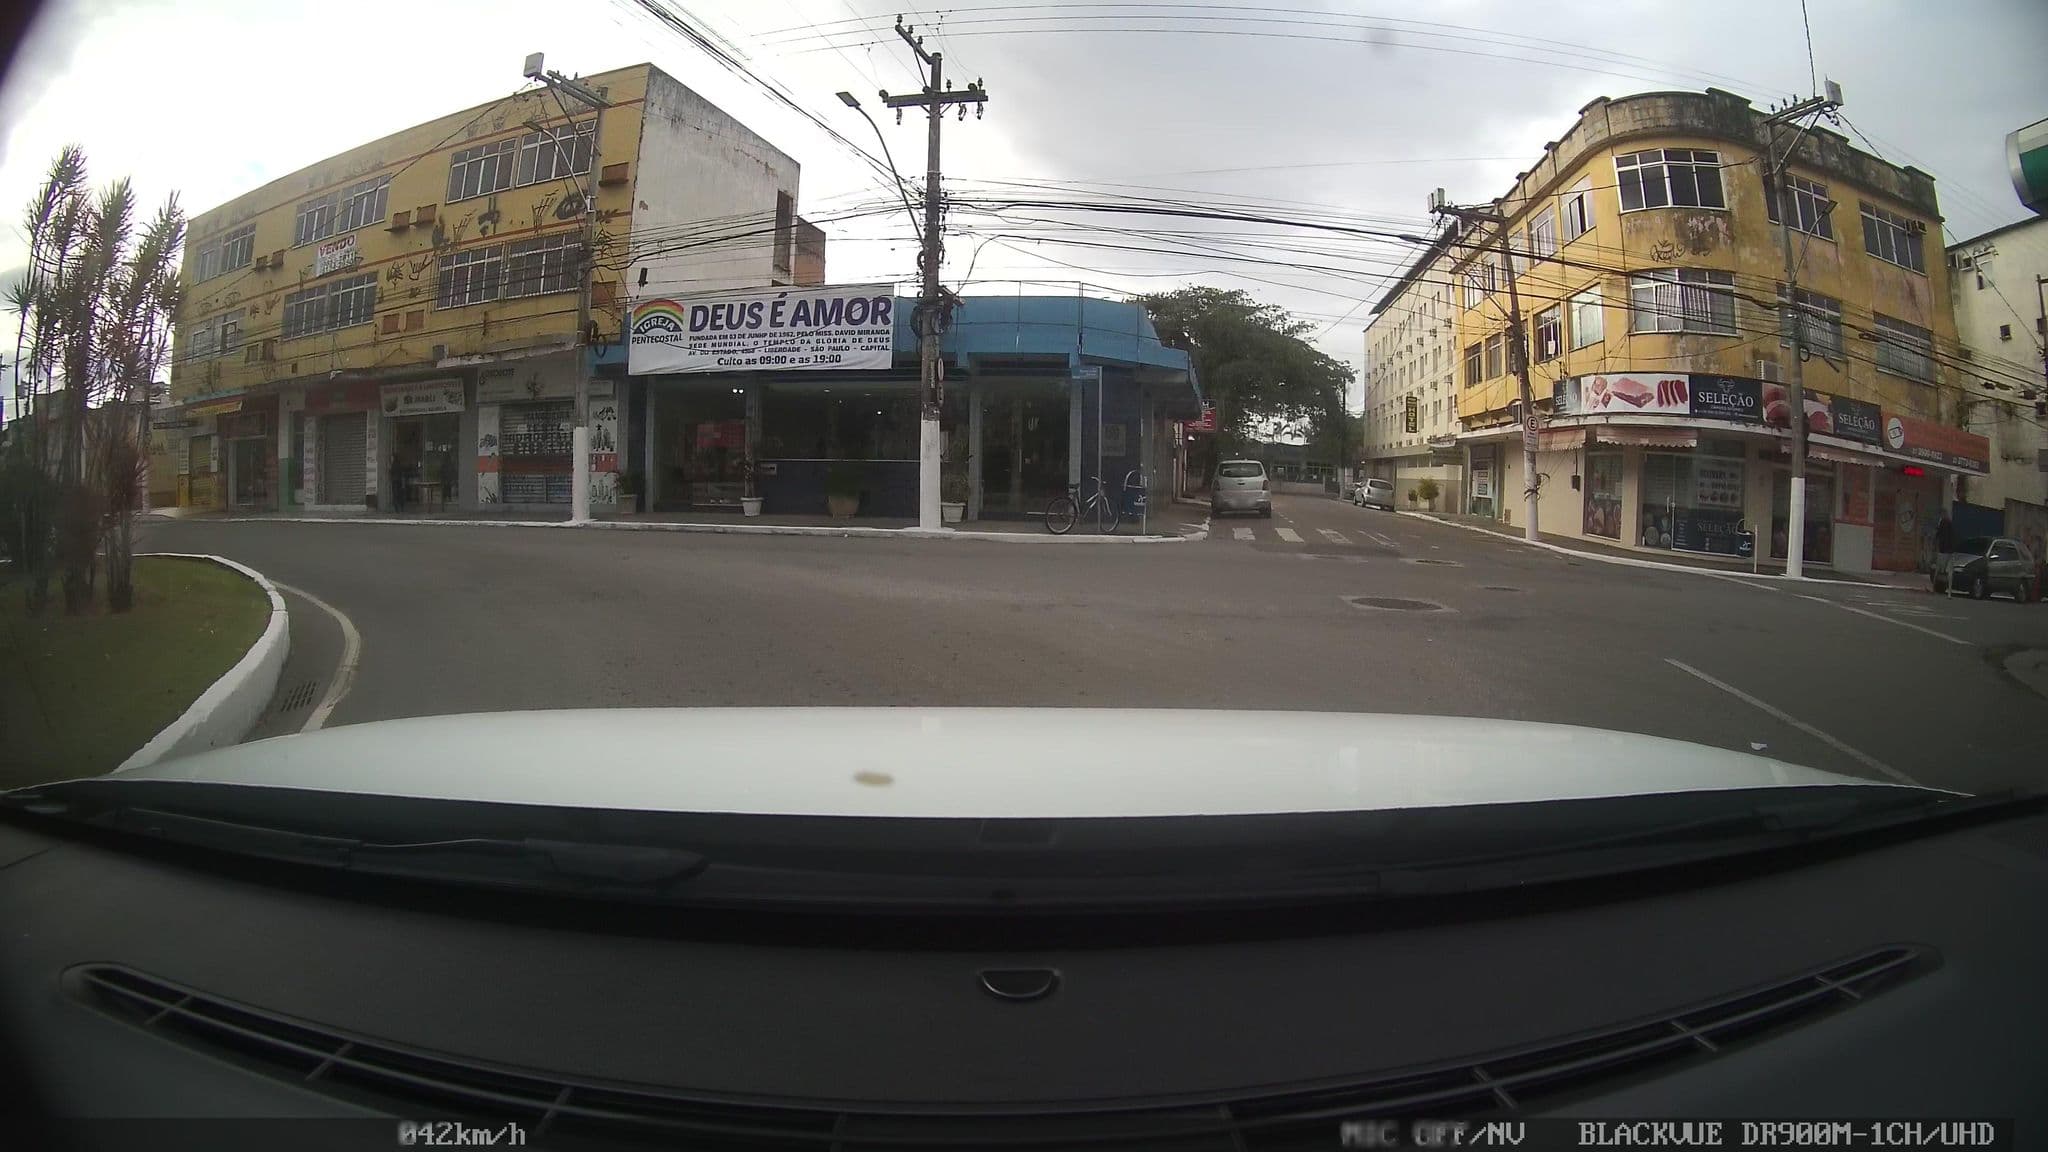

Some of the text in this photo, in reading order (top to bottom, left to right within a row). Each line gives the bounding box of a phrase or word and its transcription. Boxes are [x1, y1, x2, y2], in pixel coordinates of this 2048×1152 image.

[320, 235, 355, 256] VENDO
[689, 291, 892, 332] DEUS É AMOR
[640, 317, 675, 333] IGREJA
[631, 333, 683, 345] PENTECOSTAL
[689, 334, 717, 342] FUNDADA
[810, 344, 825, 352] SÃO
[717, 354, 842, 366] Culto as 09:00 e as 19:00
[1698, 391, 1754, 408] SELEÇÃO
[1838, 412, 1875, 431] SELEÇÃO
